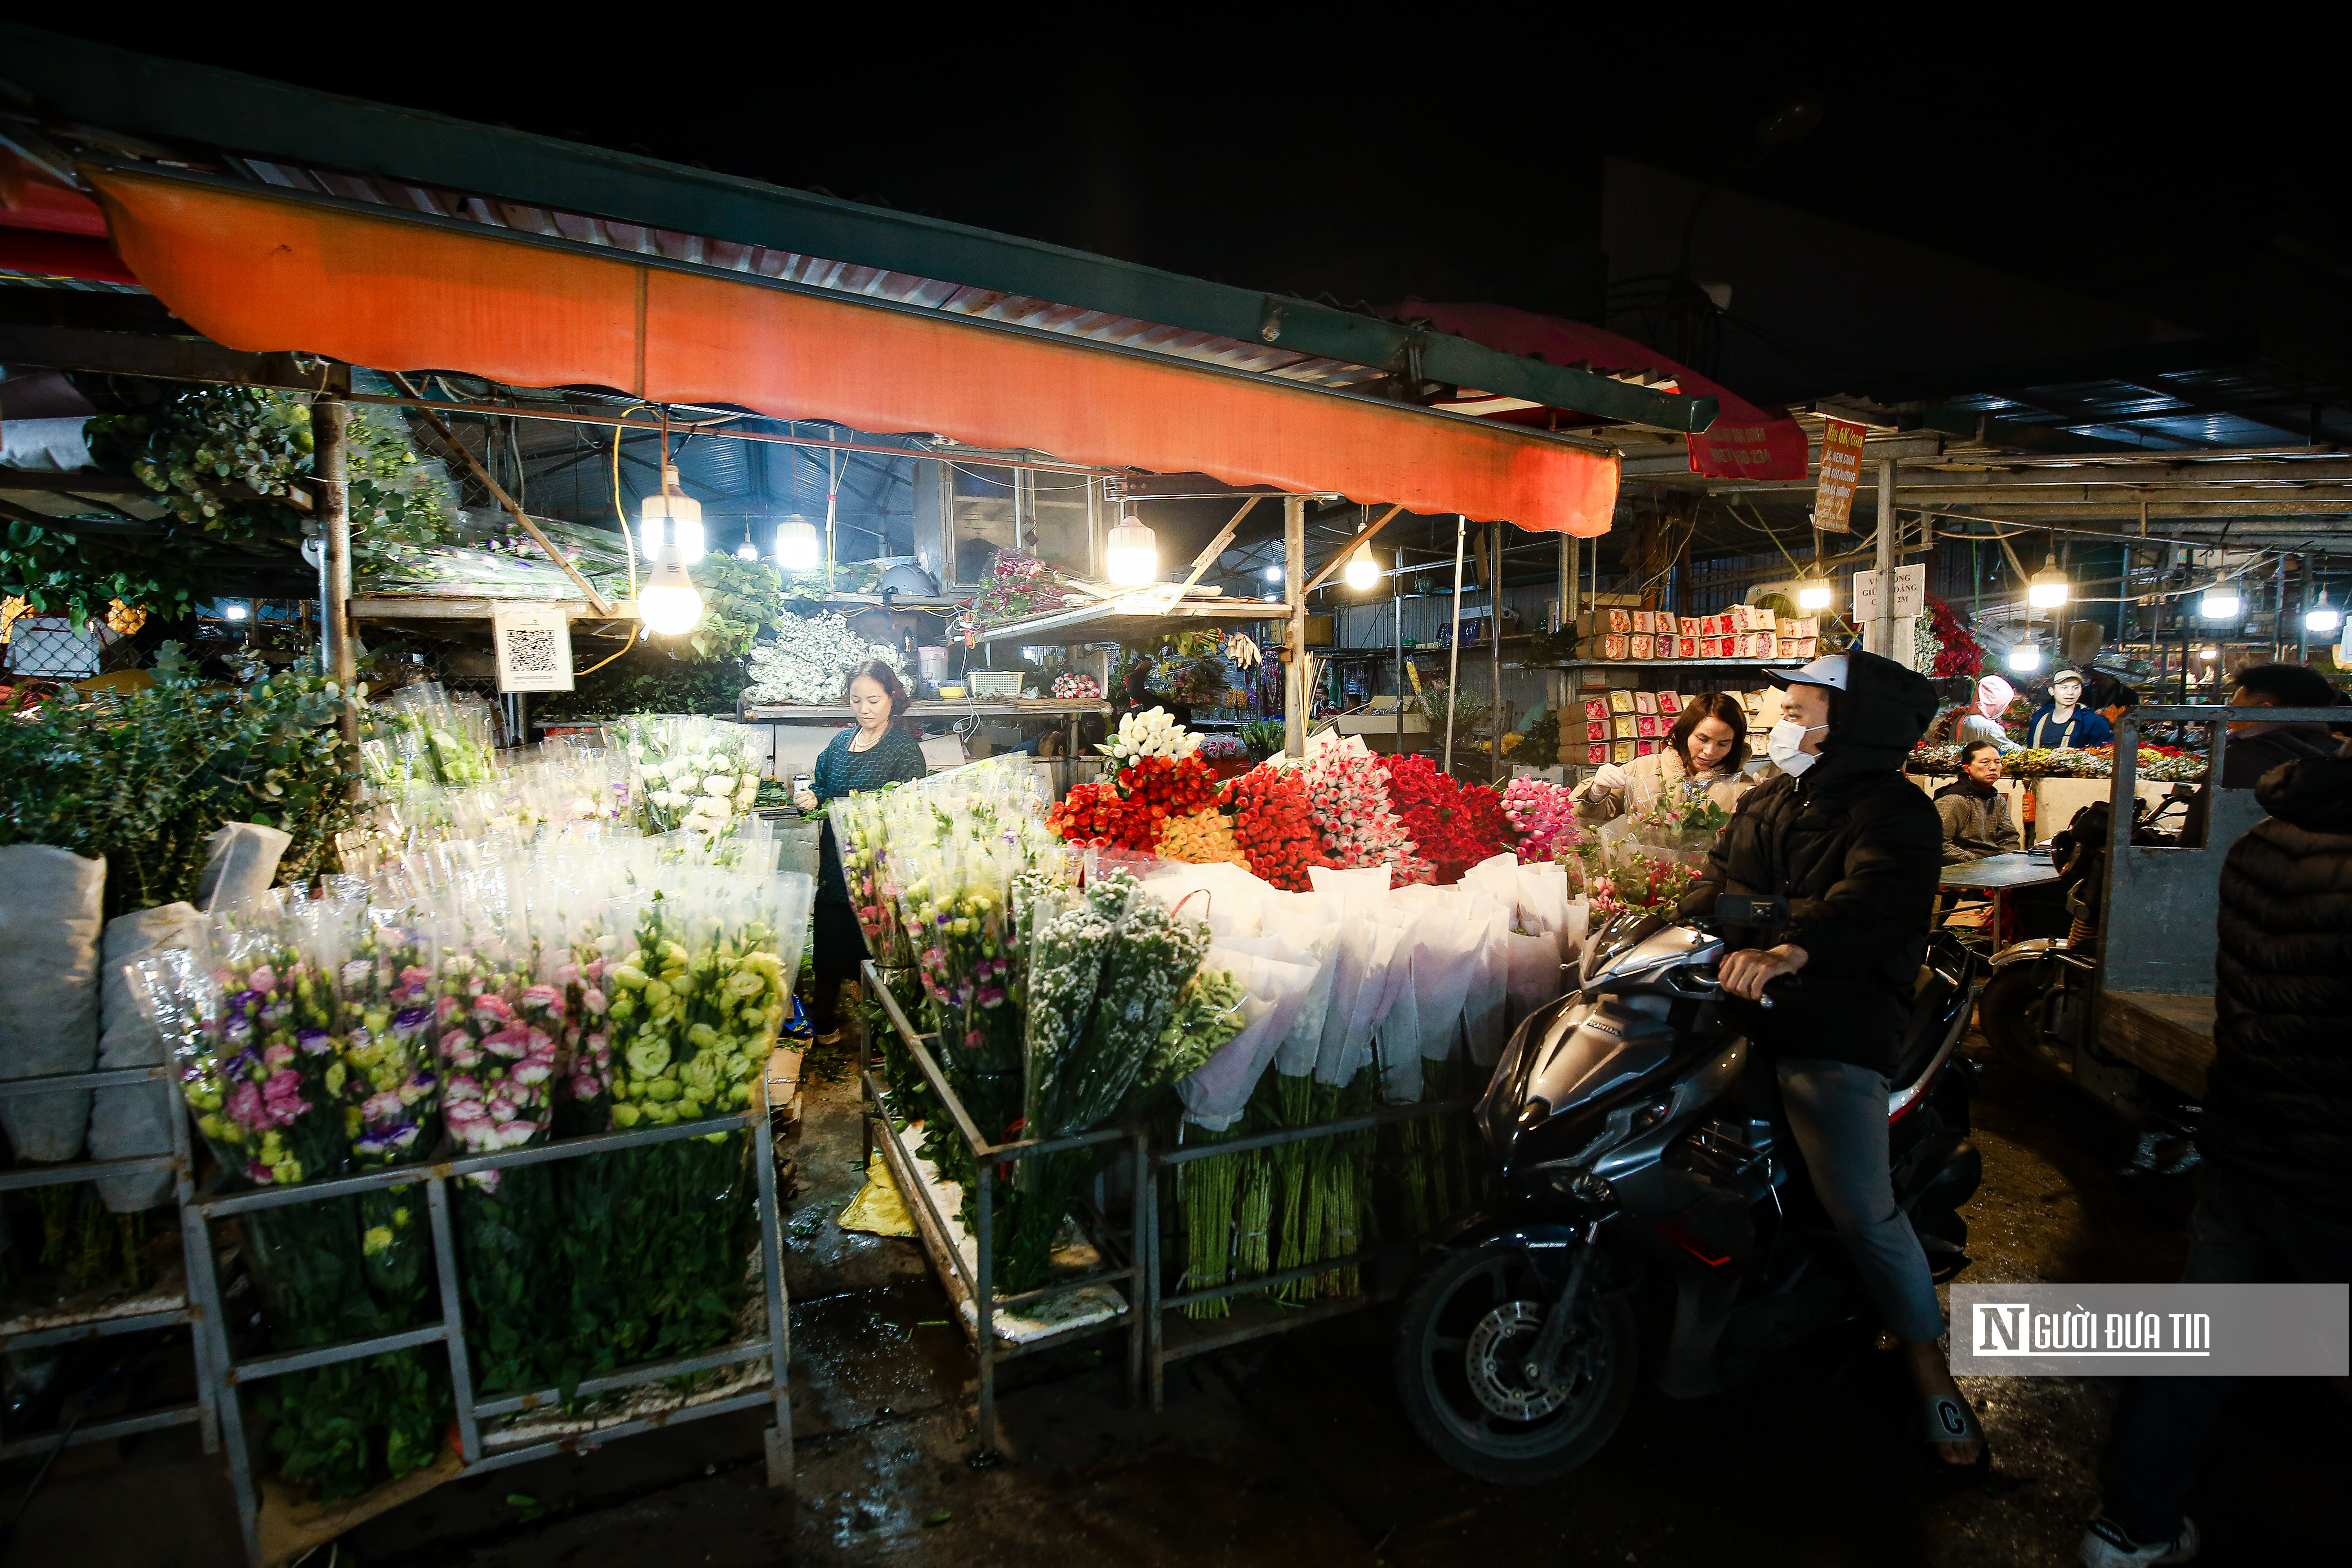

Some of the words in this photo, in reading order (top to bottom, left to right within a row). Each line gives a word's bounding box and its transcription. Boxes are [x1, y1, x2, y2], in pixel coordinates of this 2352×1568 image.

[1838, 427, 1864, 448] 6K/con
[1833, 452, 1843, 463] NEM
[1843, 454, 1856, 466] CHUA
[1894, 584, 1917, 593] OẢNG
